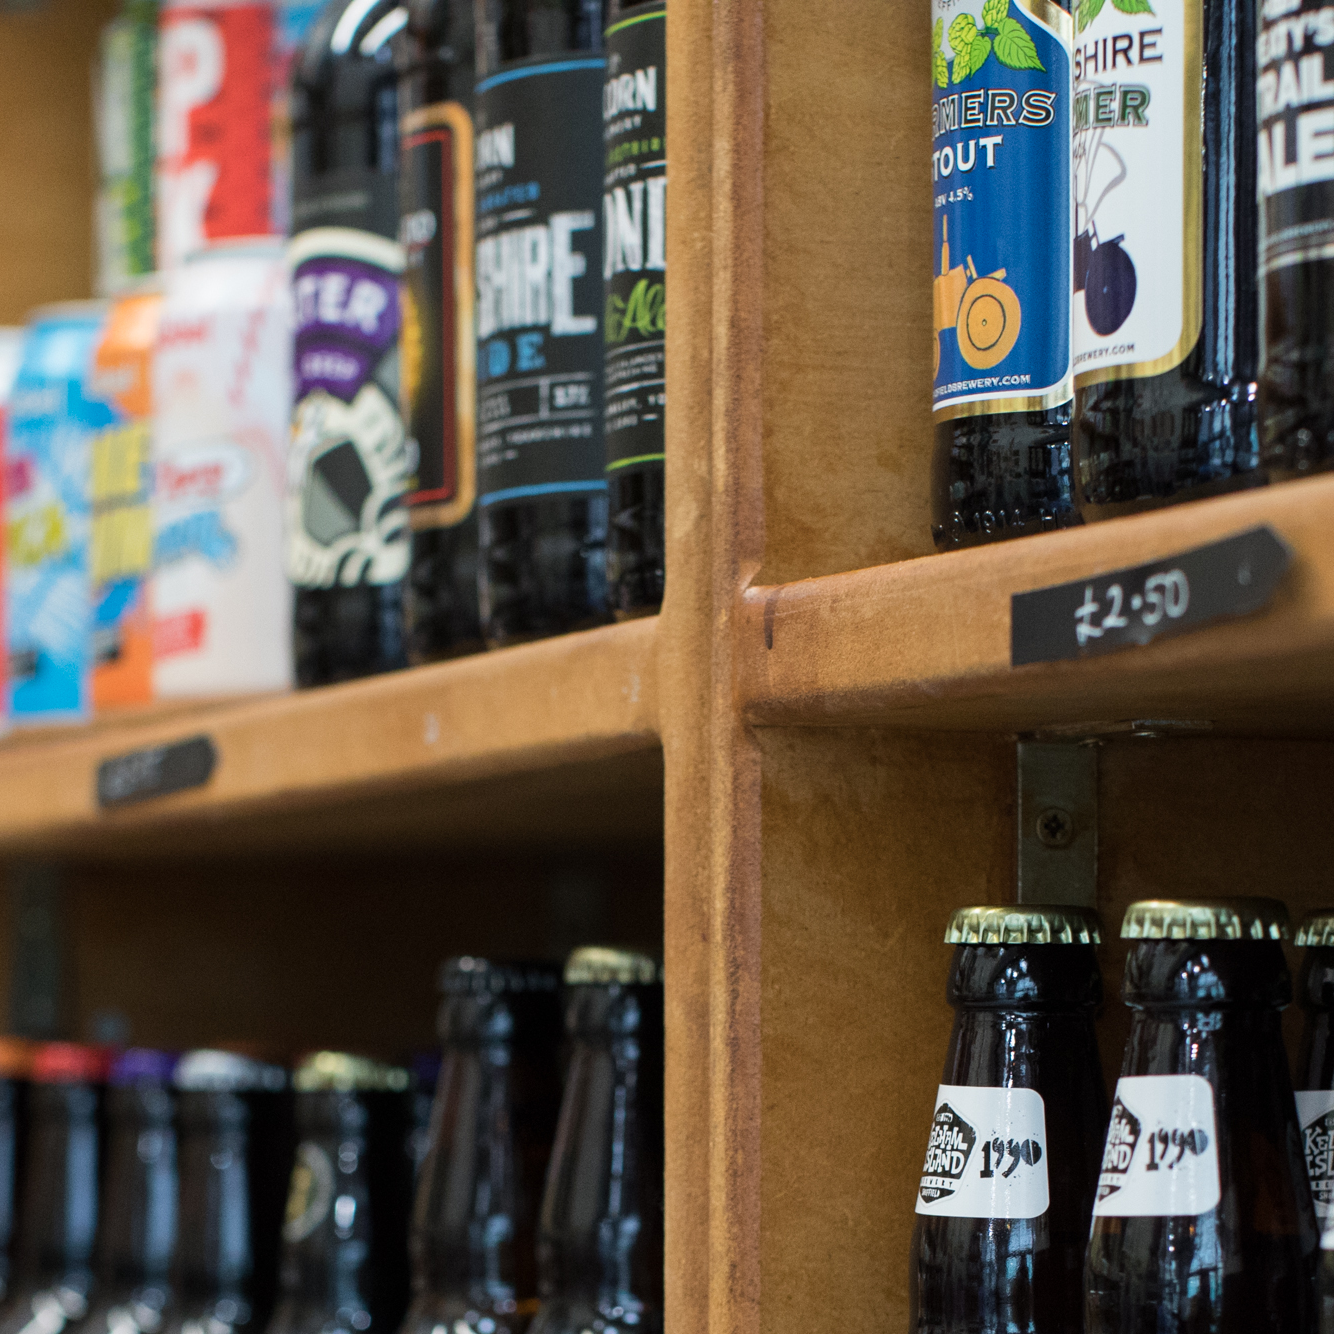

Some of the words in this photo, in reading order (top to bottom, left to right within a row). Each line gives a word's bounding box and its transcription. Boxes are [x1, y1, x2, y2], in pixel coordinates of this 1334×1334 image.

[932, 134, 1004, 182] TOUT
[1074, 568, 1190, 647] £2.50
[979, 1136, 1043, 1179] 1990
